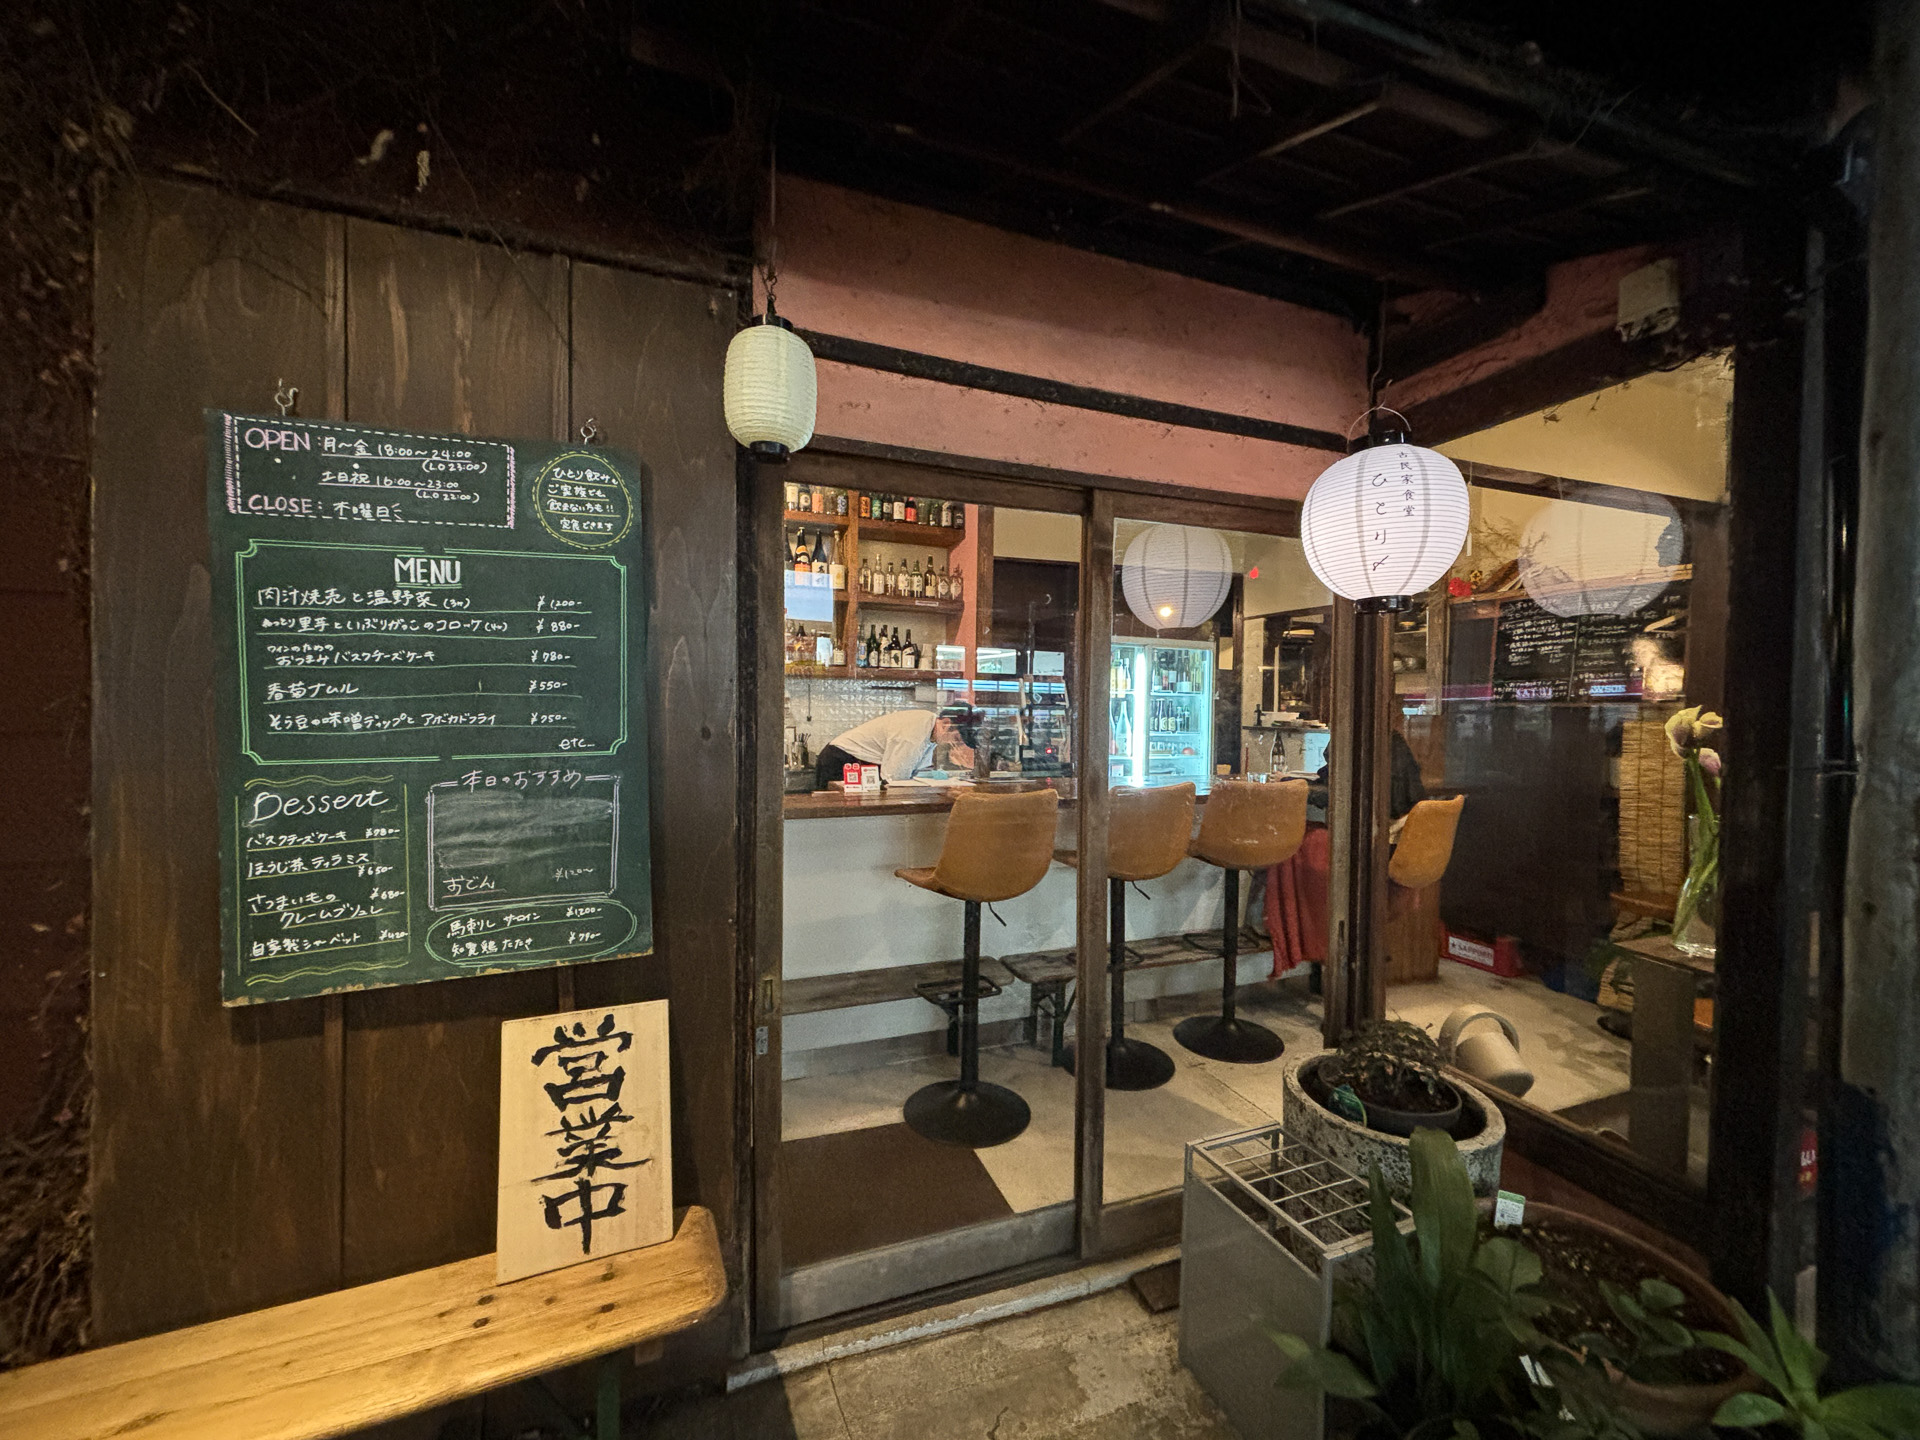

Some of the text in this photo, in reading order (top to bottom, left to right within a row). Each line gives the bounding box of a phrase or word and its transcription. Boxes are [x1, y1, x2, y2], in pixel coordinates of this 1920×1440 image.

[321, 471, 371, 484] 土日祝
[333, 501, 390, 519] 木曜日
[394, 557, 461, 584] MENU
[267, 681, 359, 700] 春菊ナムル
[461, 770, 582, 793] 本日のおすすめ
[249, 789, 389, 823] Dessert
[246, 830, 347, 848] バスクチーズケーキ
[442, 875, 496, 898] おでん
[248, 892, 337, 913] さつまいもの
[531, 1013, 653, 1256] 営業中
